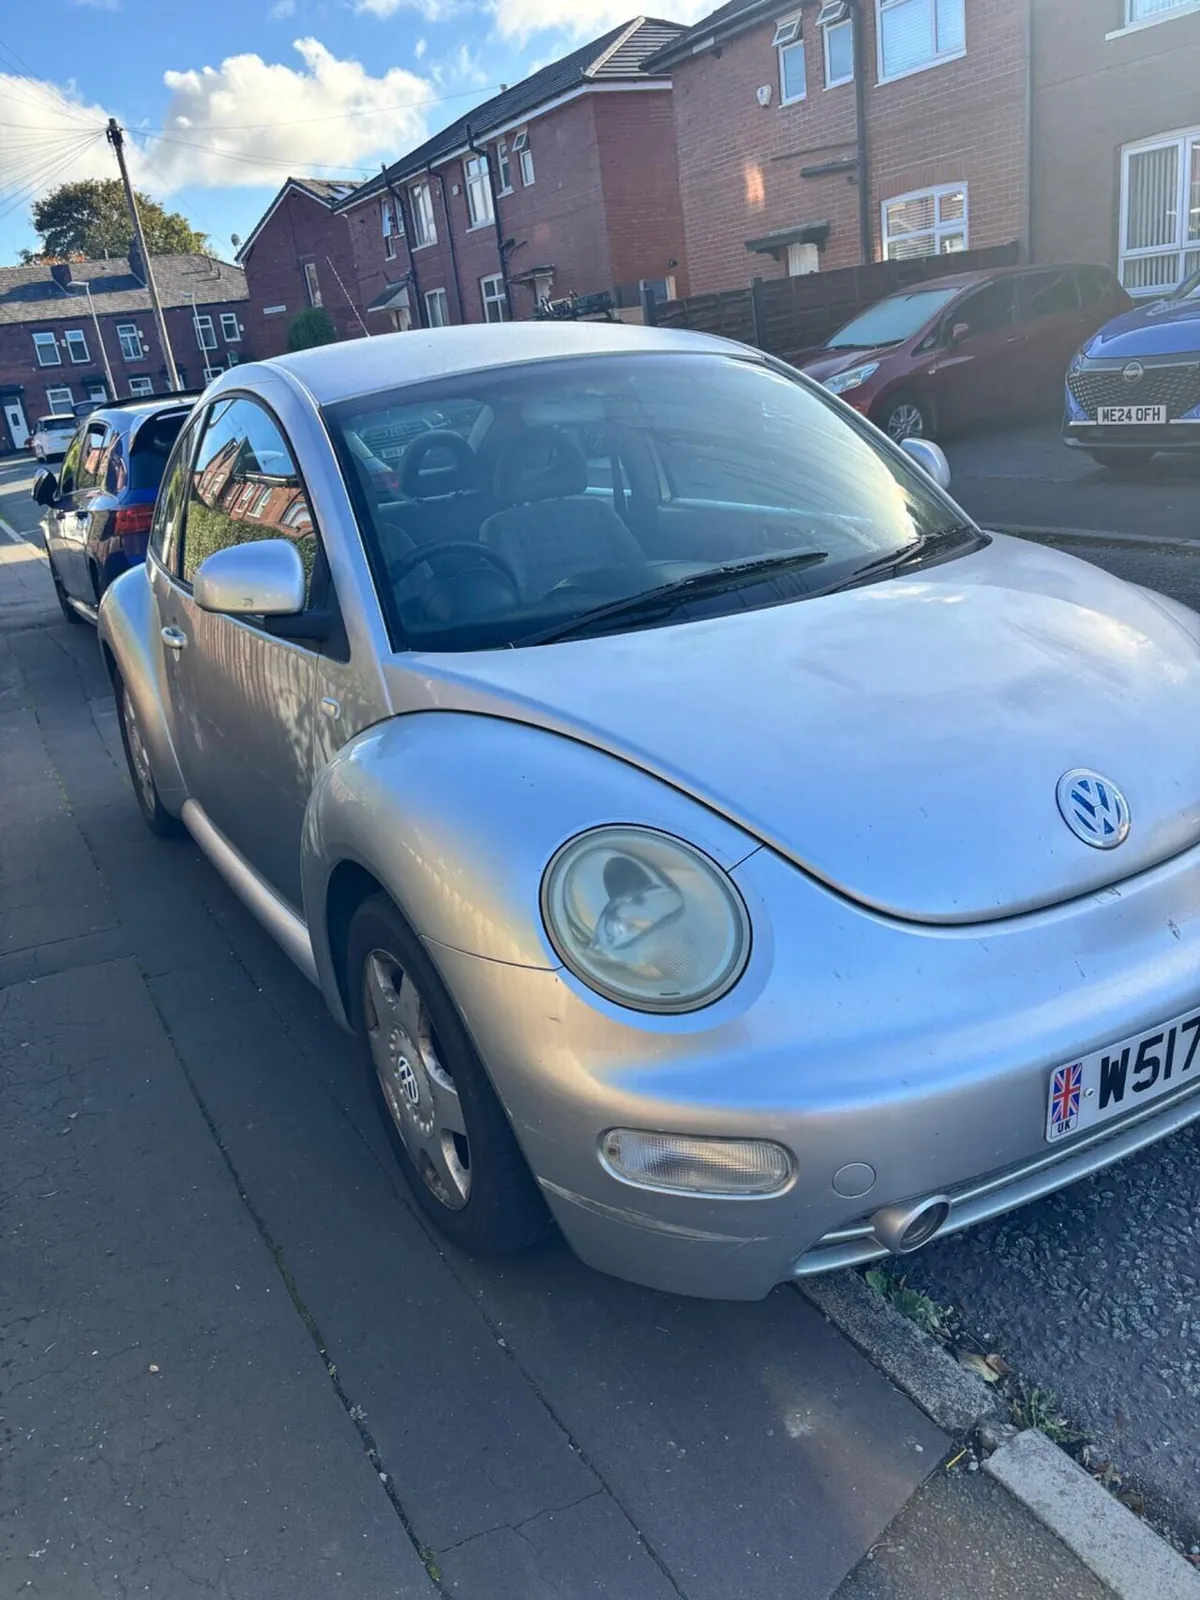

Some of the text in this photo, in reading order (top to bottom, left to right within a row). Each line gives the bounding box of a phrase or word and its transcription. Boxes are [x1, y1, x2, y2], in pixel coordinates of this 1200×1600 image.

[1102, 407, 1161, 422] ME24 OFH
[1064, 775, 1123, 842] VW
[1098, 1015, 1200, 1110] W517
[1057, 1118, 1071, 1133] UK
